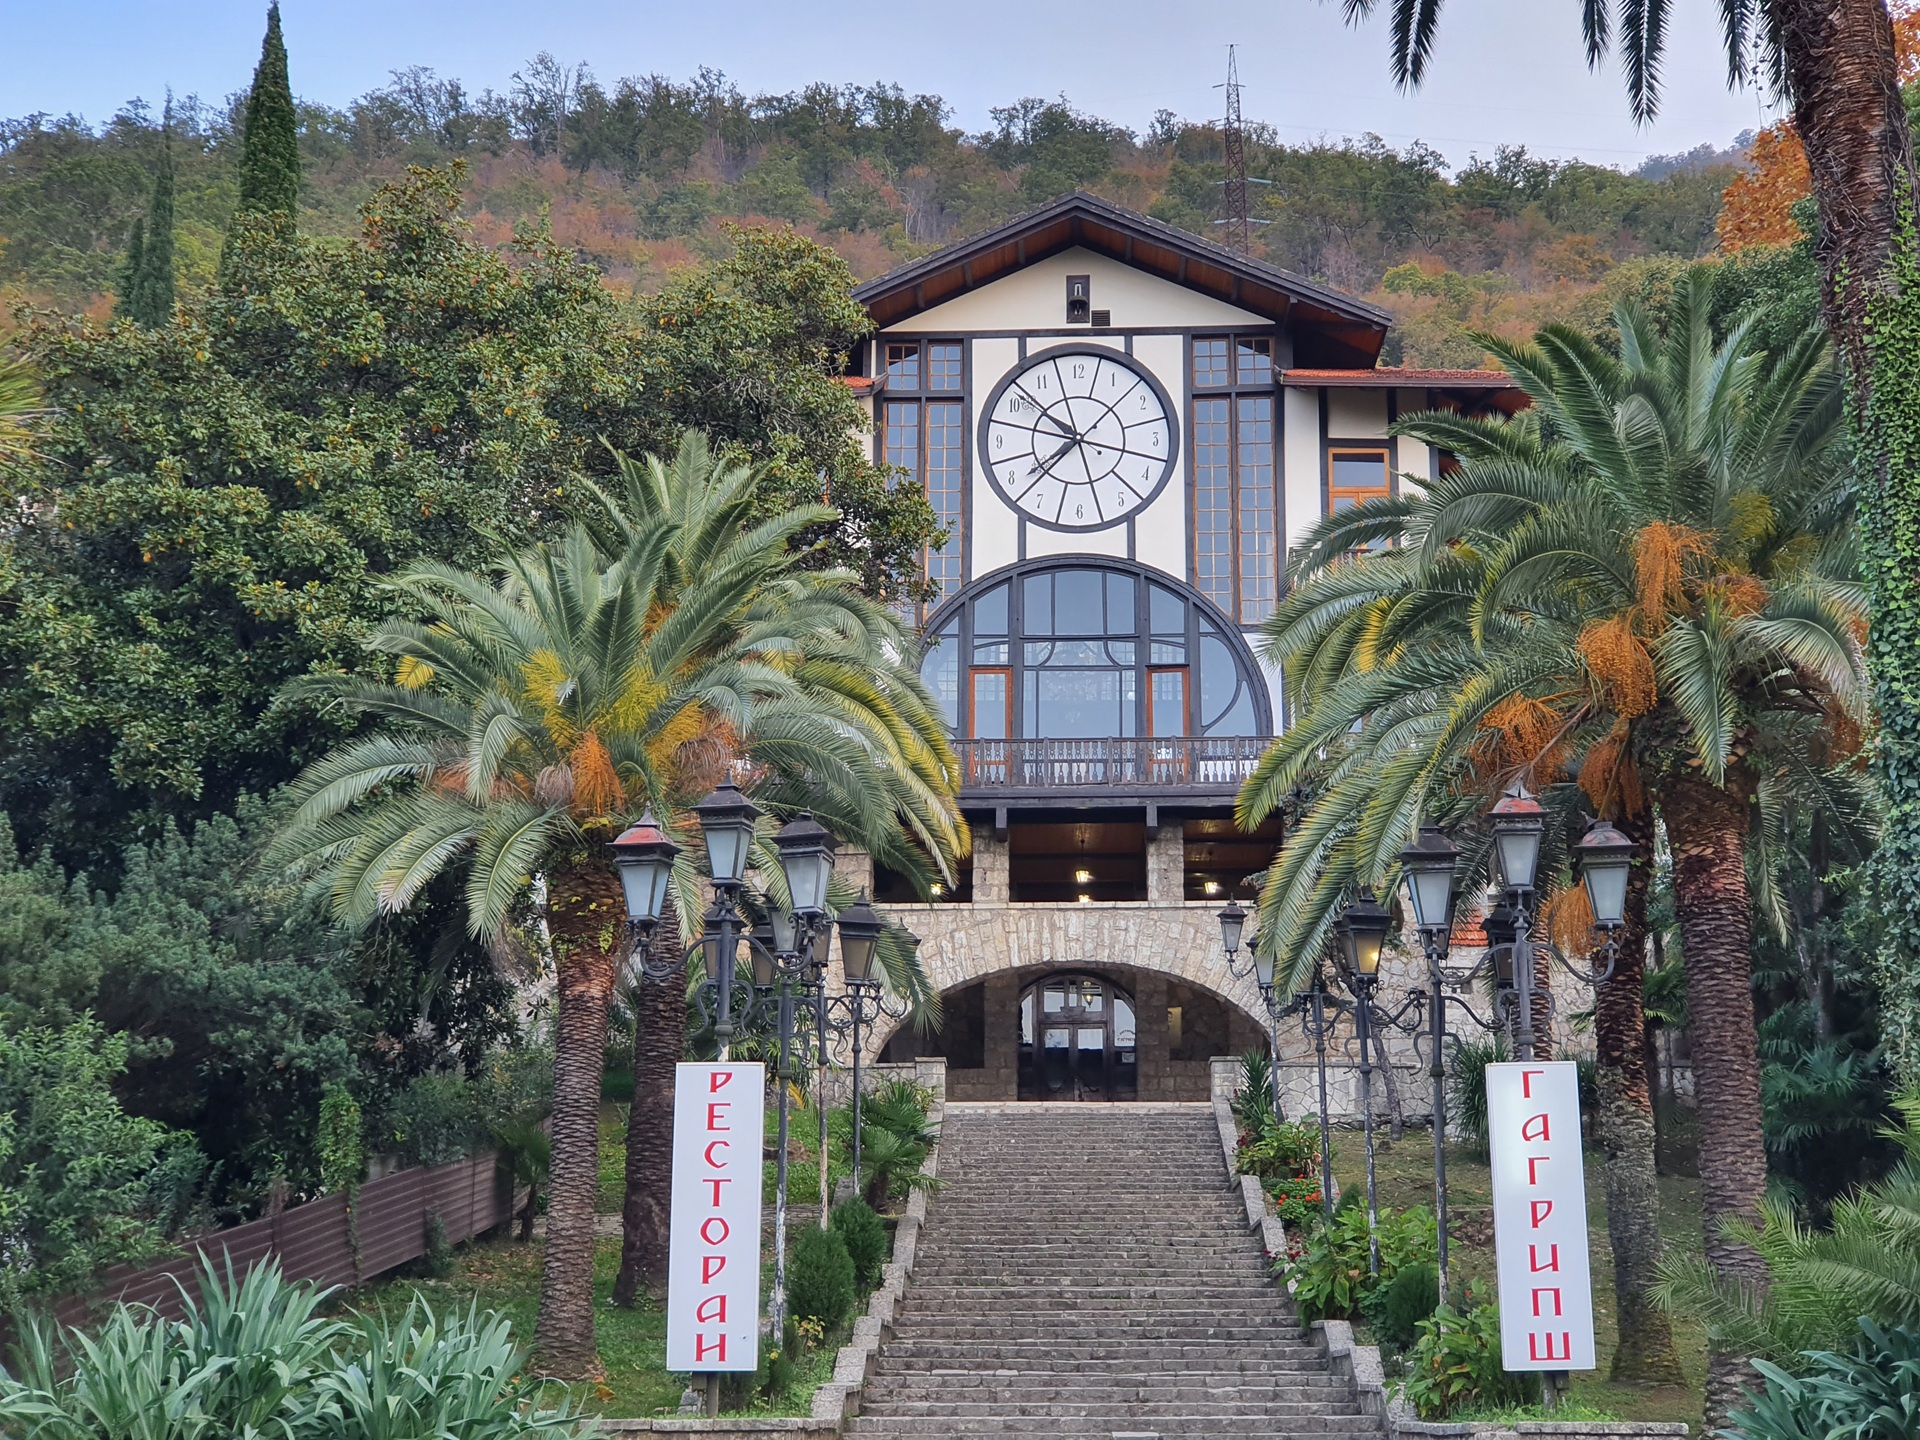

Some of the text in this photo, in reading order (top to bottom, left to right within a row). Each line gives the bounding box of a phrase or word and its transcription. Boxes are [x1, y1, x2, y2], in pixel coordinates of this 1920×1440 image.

[1072, 363, 1085, 379] 12
[1110, 371, 1116, 387] 1
[1036, 374, 1047, 389] 11
[1009, 398, 1020, 413] 10
[1139, 395, 1147, 411] 2
[995, 434, 1003, 449] 9
[1152, 431, 1159, 447] 3
[1007, 470, 1015, 485] 8
[1141, 465, 1150, 481] 4
[1036, 493, 1044, 509] 7
[1117, 491, 1125, 507] 5
[1075, 503, 1083, 519] 6
[694, 1071, 733, 1362] РЕСТОРАН
[1521, 1070, 1572, 1361] ГАГРИПШ
